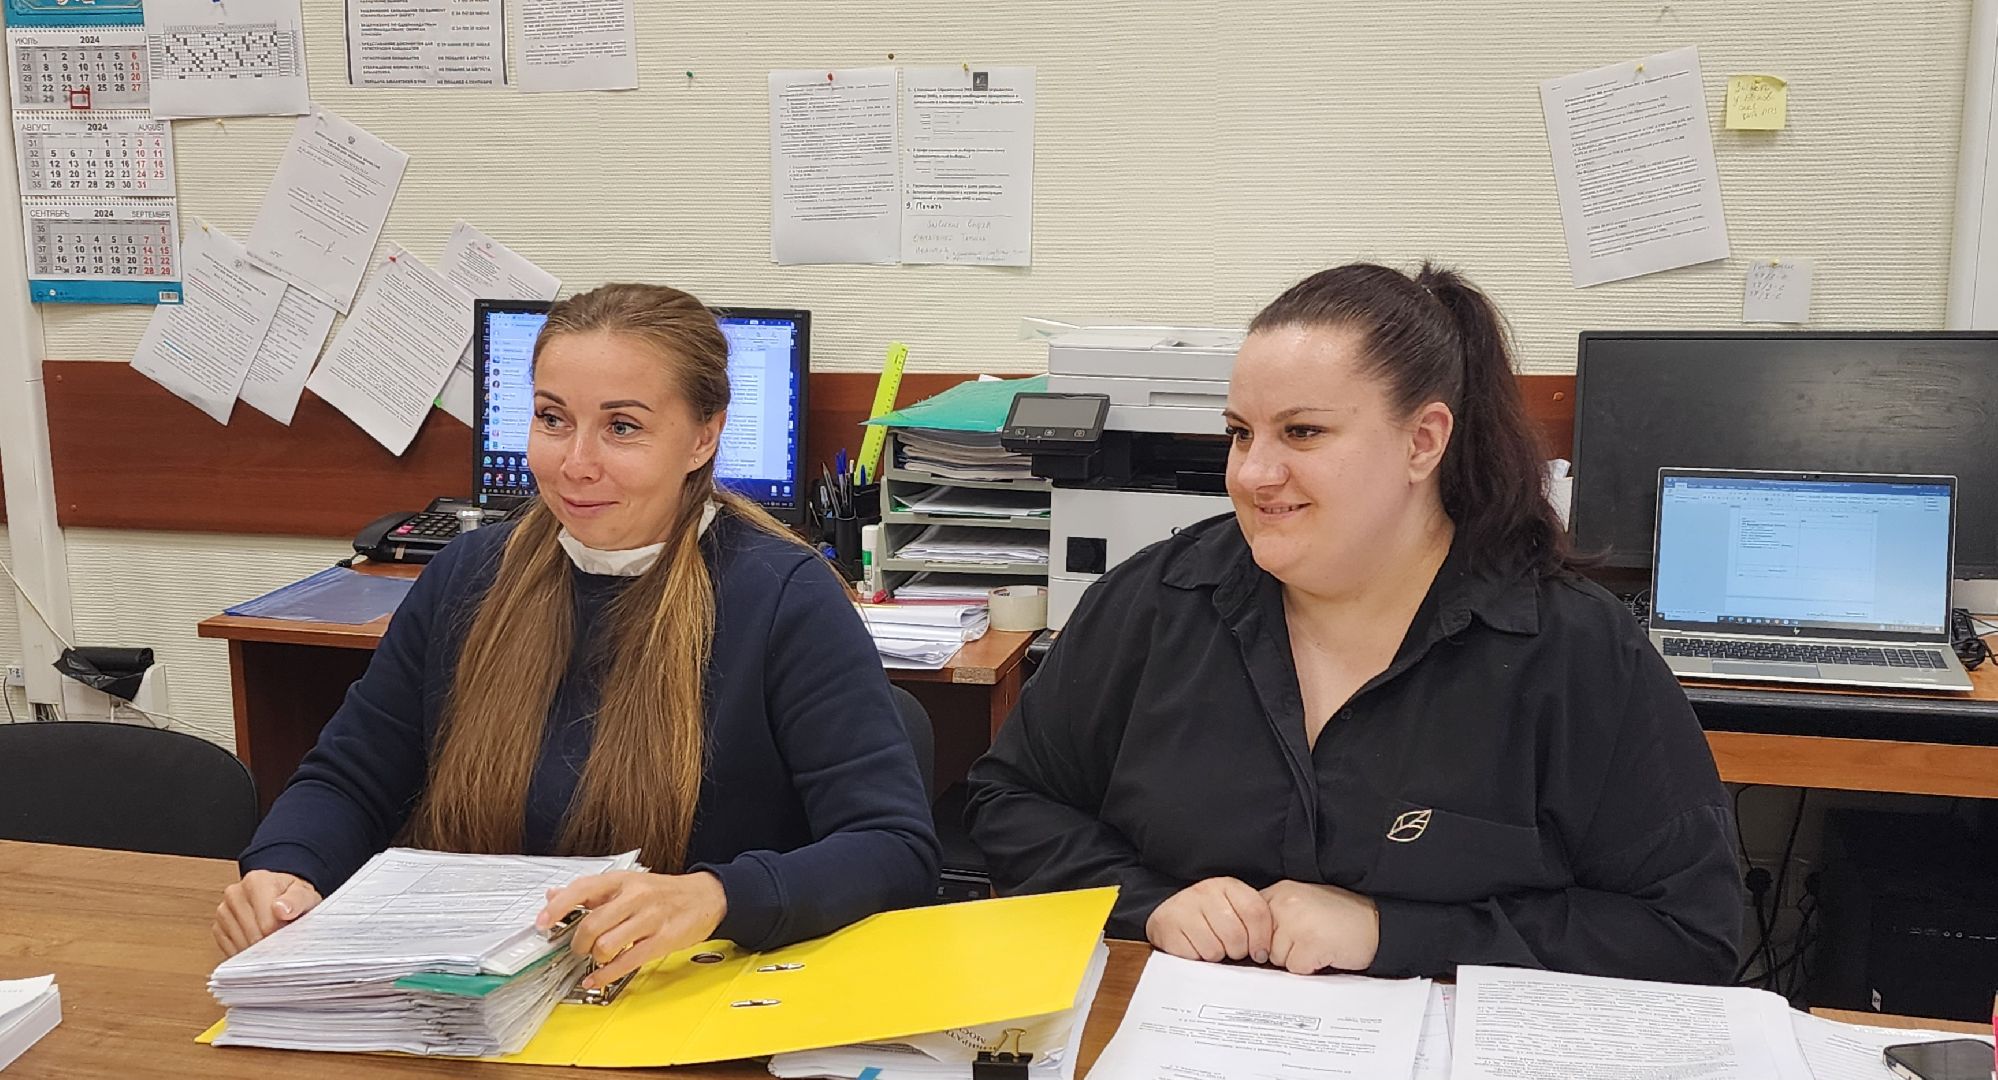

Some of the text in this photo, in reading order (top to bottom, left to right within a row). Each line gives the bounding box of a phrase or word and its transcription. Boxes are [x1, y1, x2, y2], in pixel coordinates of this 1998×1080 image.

[15, 37, 38, 45] ИЮЛЬ
[115, 52, 120, 60] 5
[132, 52, 137, 60] 6
[79, 63, 88, 71] 10
[131, 62, 139, 70] 13
[97, 73, 106, 81] 18
[114, 73, 124, 81] 19
[131, 73, 140, 81] 20
[43, 84, 53, 92] 22
[62, 84, 72, 92] 23
[88, 123, 108, 131] 2024
[138, 123, 164, 131] AUGUST
[122, 139, 126, 147] 2
[50, 160, 60, 168] 12
[69, 160, 79, 168] 13
[121, 160, 129, 168] 16
[136, 160, 145, 168] 17
[122, 170, 130, 178] 23
[154, 170, 164, 178] 25
[30, 210, 69, 219] СЕНТЯБРЬ
[58, 235, 62, 243] 2
[127, 246, 136, 254] 13
[161, 256, 170, 265] 22
[112, 266, 120, 274] 26
[161, 267, 170, 275] 29
